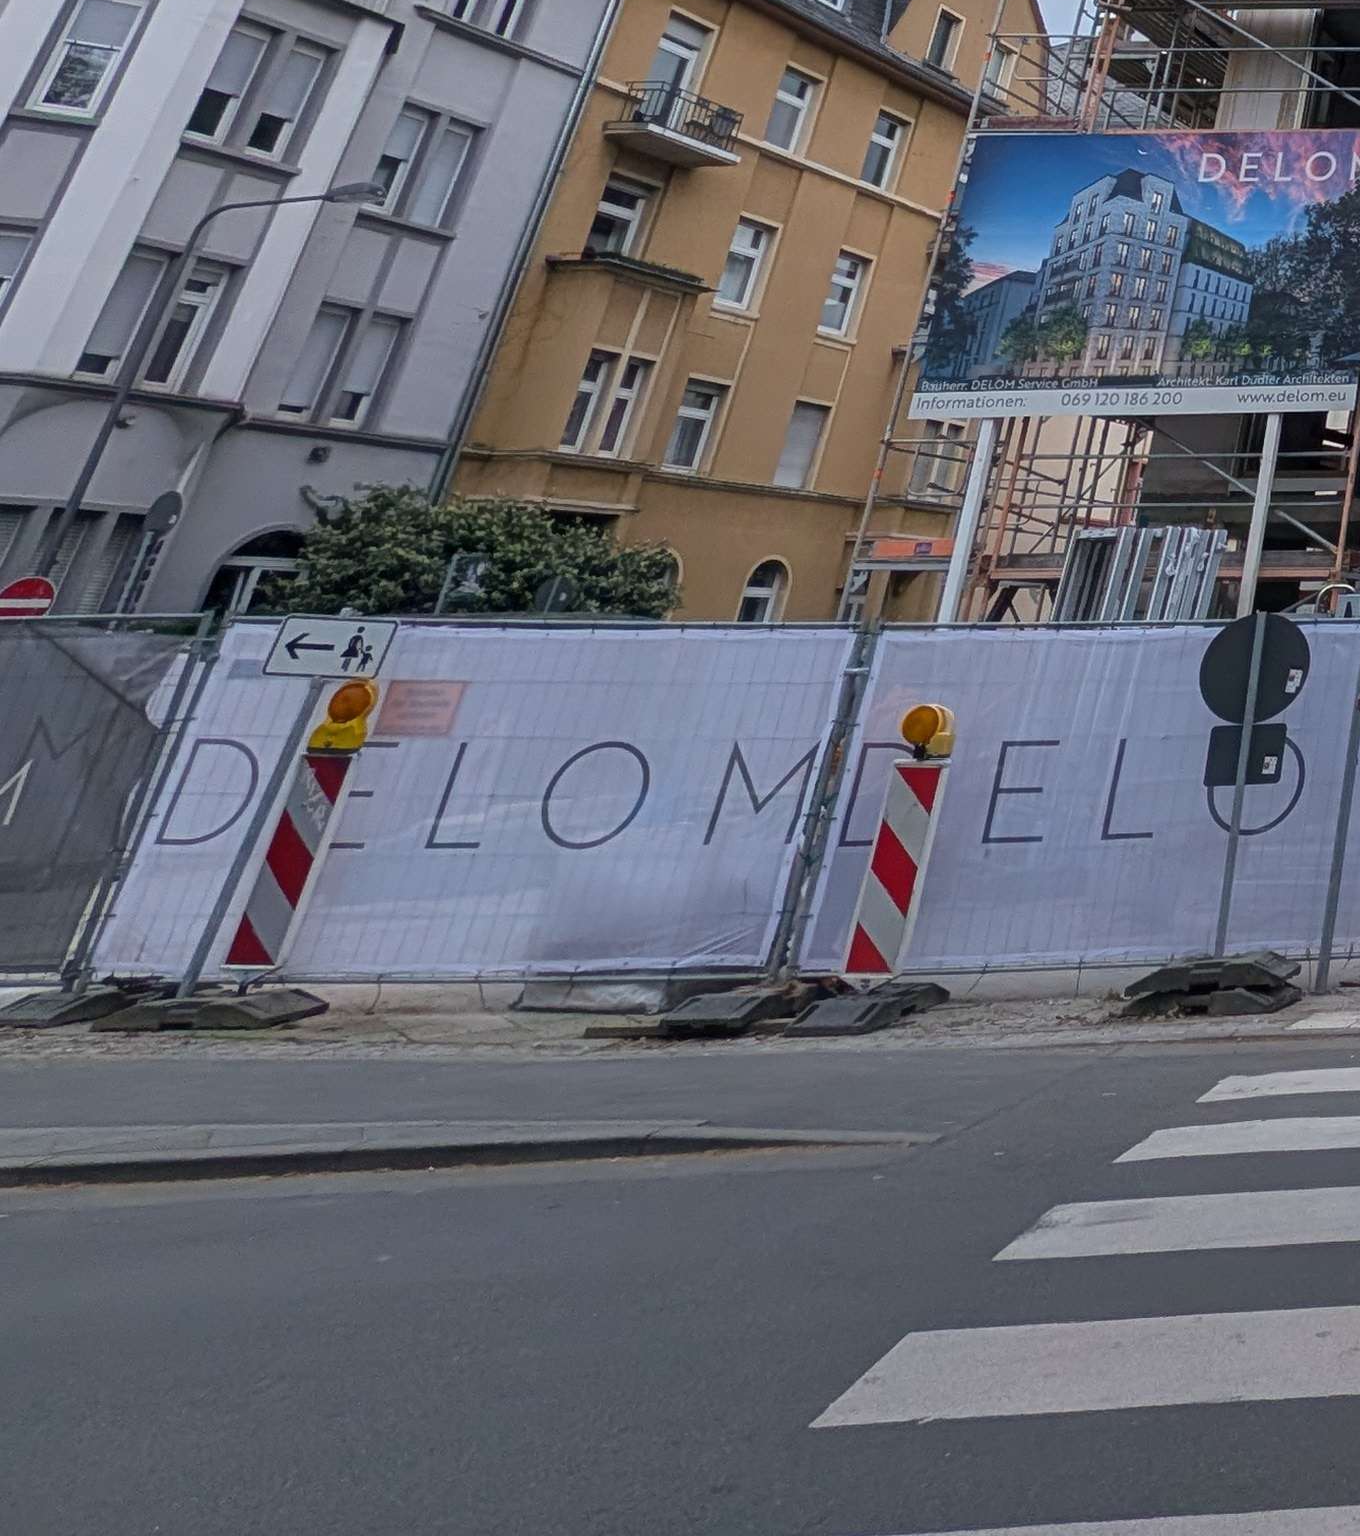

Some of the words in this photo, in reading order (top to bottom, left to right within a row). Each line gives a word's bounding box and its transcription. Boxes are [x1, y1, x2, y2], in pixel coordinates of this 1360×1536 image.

[971, 378, 1016, 391] DELOM
[1018, 378, 1059, 389] Service
[1061, 377, 1099, 388] GmbH
[1215, 376, 1239, 386] Karl
[1242, 374, 1281, 386] Dudler
[1283, 373, 1350, 385] Architekten
[1061, 392, 1091, 407] 069
[1095, 392, 1119, 406] 120
[1125, 392, 1149, 406] 186
[1152, 391, 1183, 405] 200
[1237, 389, 1347, 403] www.delom.eu
[916, 396, 1027, 411] Informationen:
